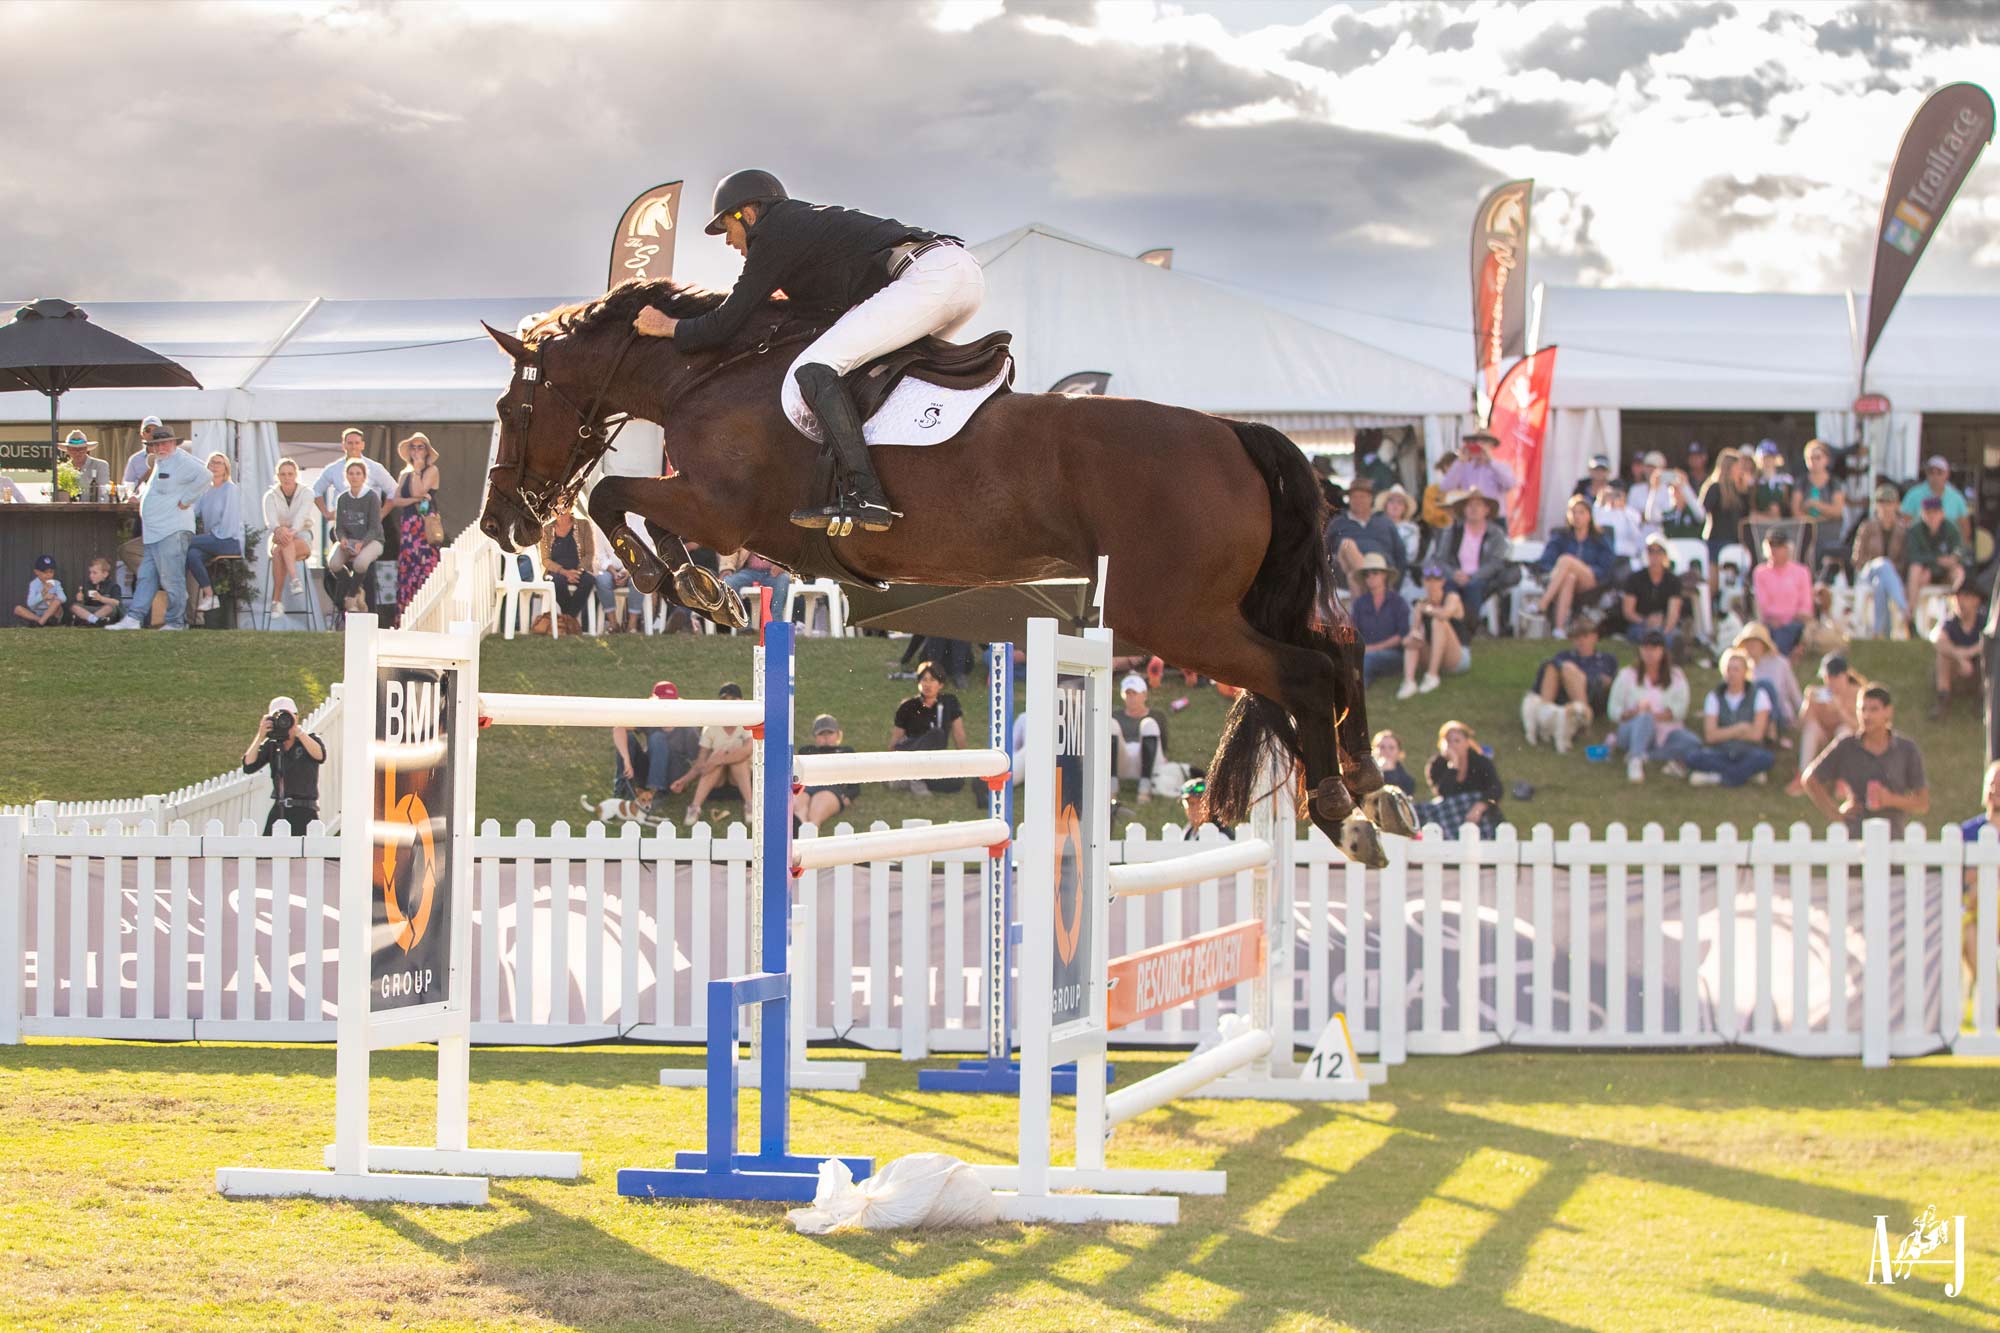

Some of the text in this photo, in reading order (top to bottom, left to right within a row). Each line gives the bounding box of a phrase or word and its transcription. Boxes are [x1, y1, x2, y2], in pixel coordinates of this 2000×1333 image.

[1908, 106, 1978, 207] Trailrace
[385, 680, 440, 746] BMI
[1056, 688, 1085, 756] BMI
[381, 969, 432, 998] GROUP
[1052, 984, 1080, 1014] GROUP
[1136, 949, 1192, 1013] RESOURCE
[1192, 934, 1242, 992] RECOVERY
[1312, 1052, 1343, 1078] 12
